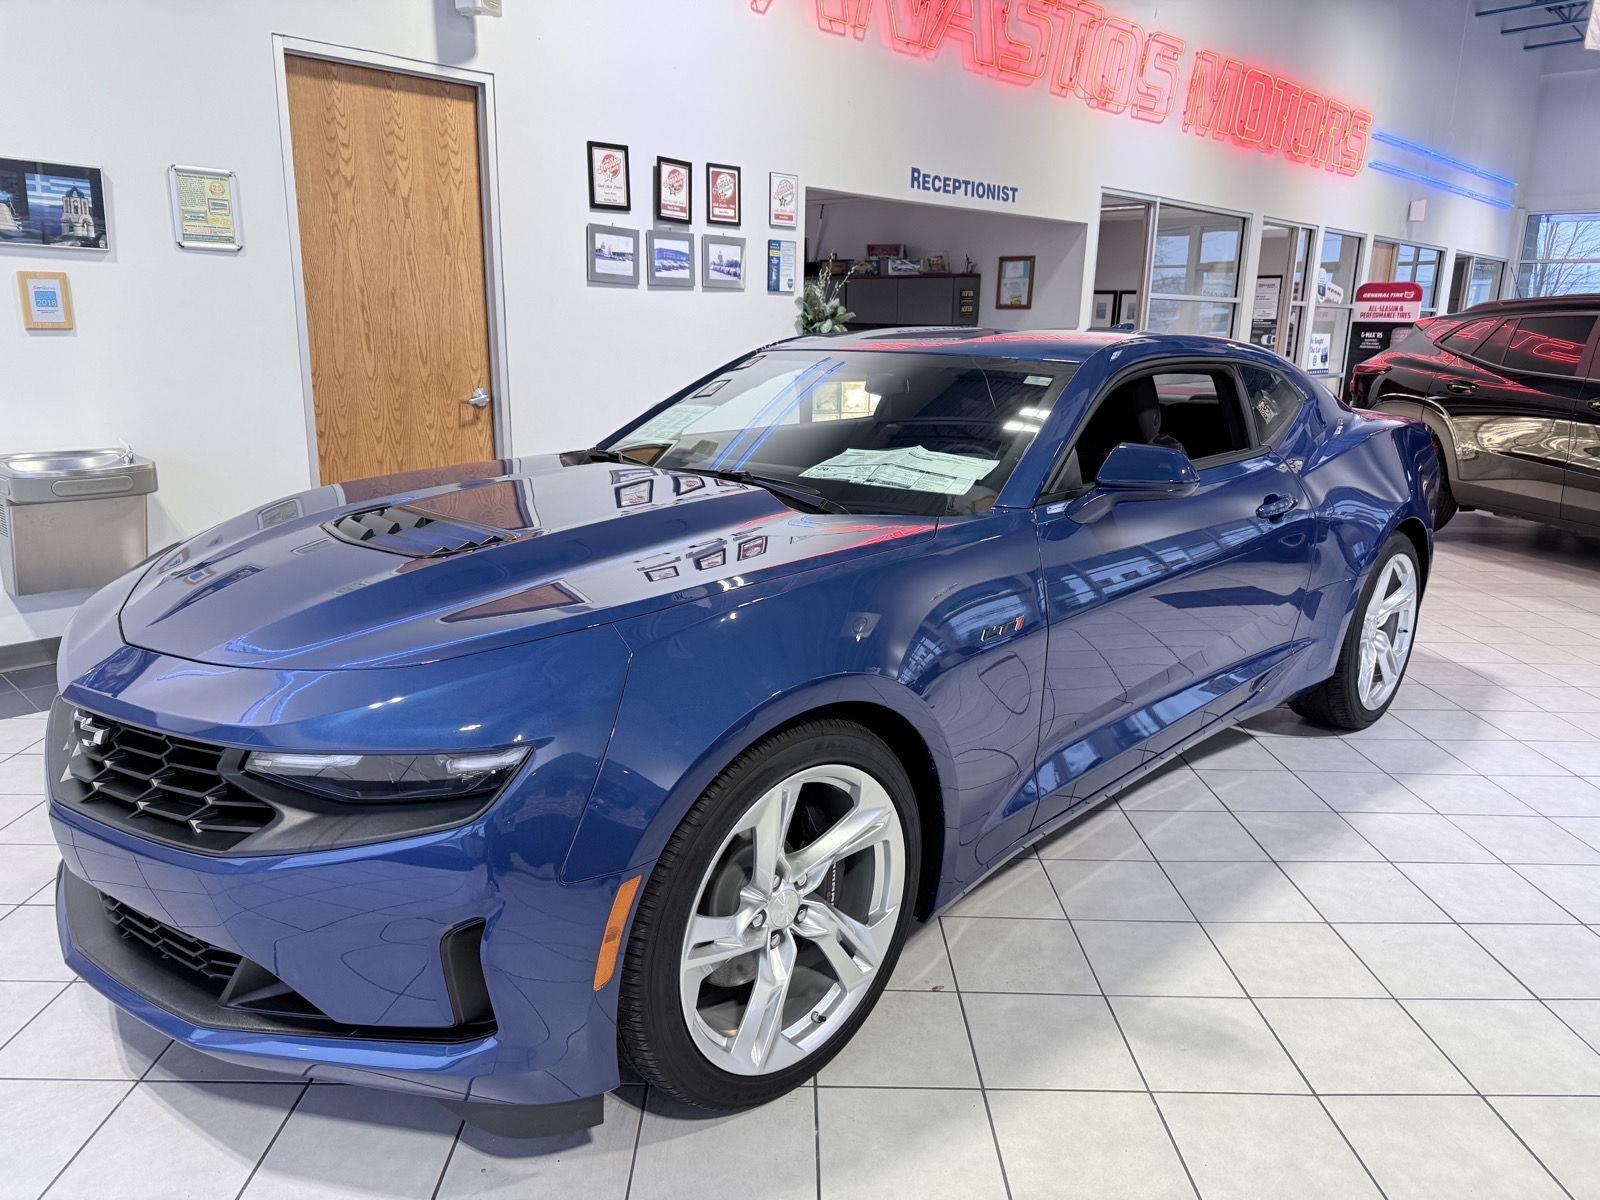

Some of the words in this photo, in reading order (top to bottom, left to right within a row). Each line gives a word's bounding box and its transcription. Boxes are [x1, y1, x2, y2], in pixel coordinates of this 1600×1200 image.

[750, 0, 1186, 124] ASTOS
[1182, 49, 1374, 177] MOTORS
[36, 299, 57, 307] 2018
